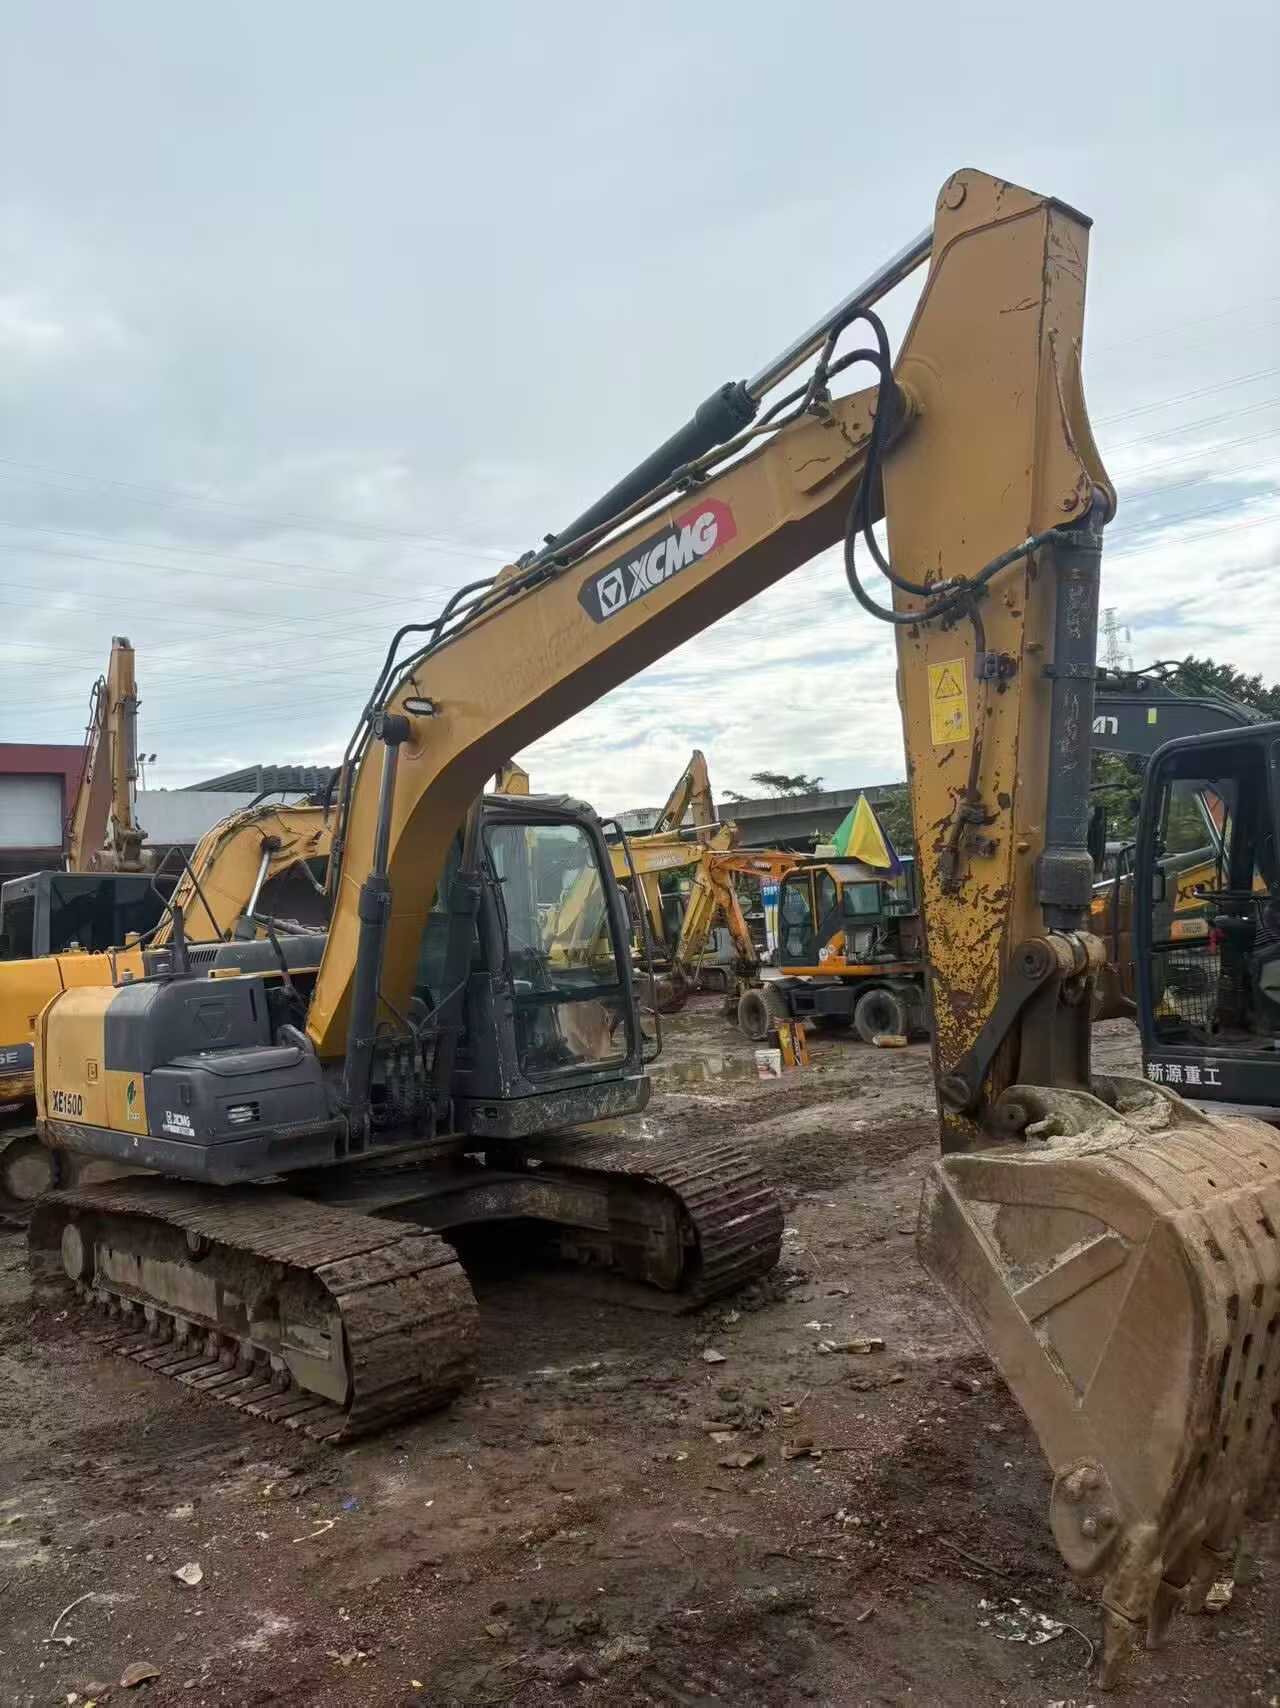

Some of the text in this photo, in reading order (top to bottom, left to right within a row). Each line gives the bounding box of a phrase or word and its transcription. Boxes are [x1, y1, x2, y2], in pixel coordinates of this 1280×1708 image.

[628, 511, 718, 602] XCMG
[1147, 1062, 1222, 1086] 新源重工
